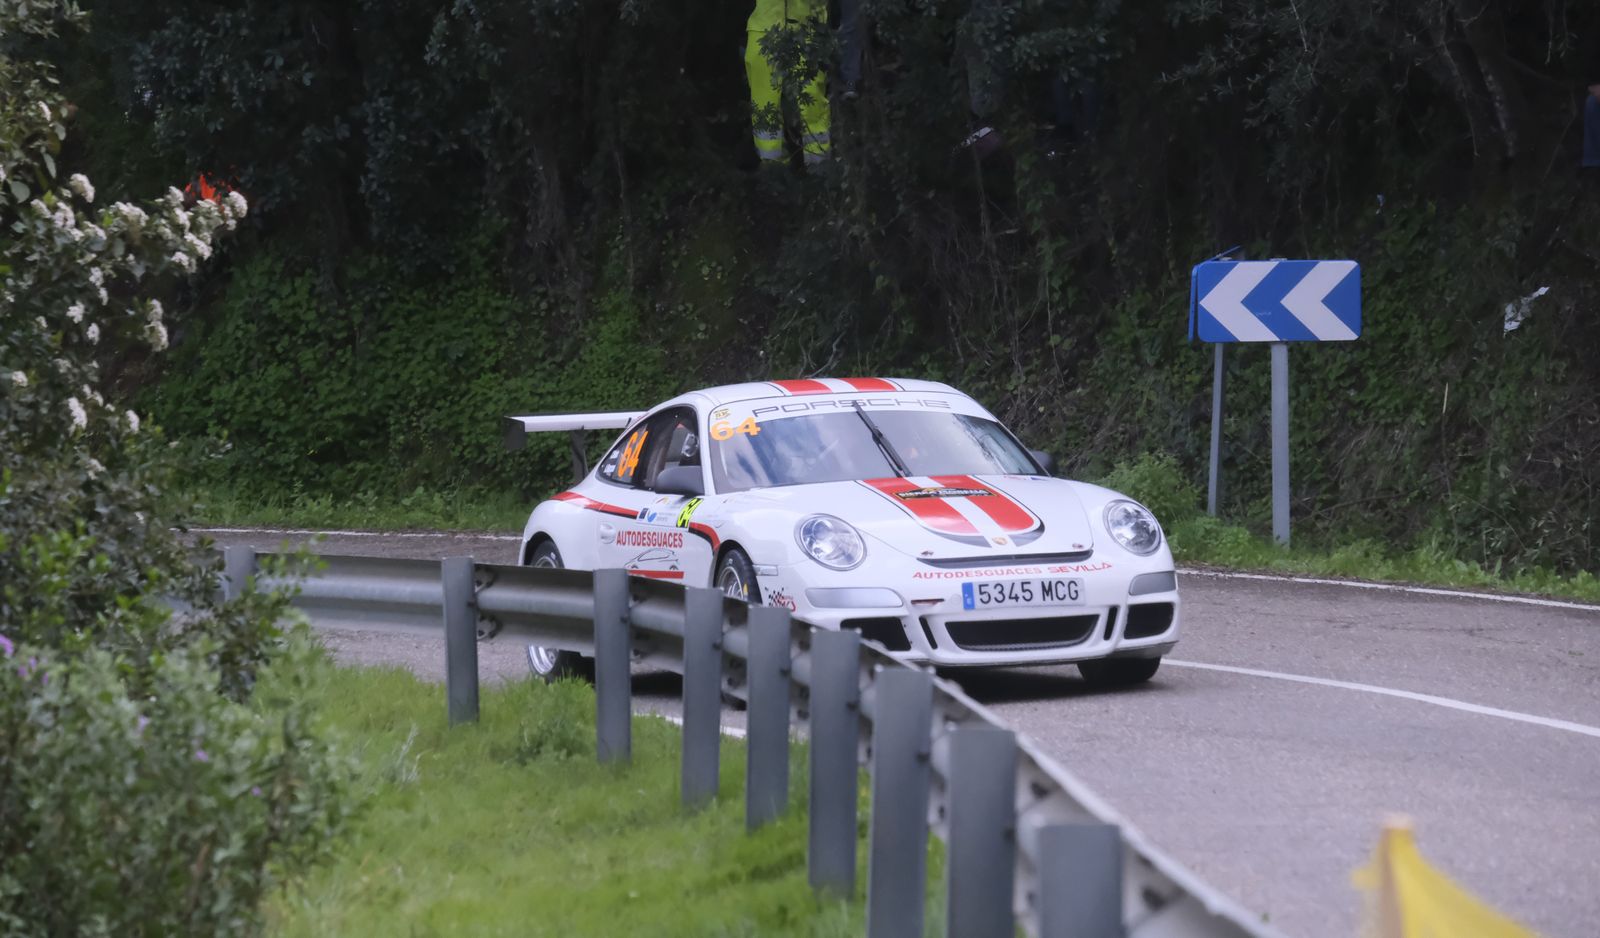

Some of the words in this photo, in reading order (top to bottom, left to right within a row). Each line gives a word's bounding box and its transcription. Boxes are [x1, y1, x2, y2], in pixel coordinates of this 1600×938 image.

[752, 398, 951, 417] PORSCHE
[711, 417, 761, 441] 64
[617, 430, 649, 478] 64
[616, 531, 683, 548] AUTODESGUACES
[913, 567, 1042, 579] AUTODESGUACES
[1048, 562, 1112, 574] SEVILLA
[978, 581, 1034, 604] 5345
[1041, 580, 1079, 602] MCG
